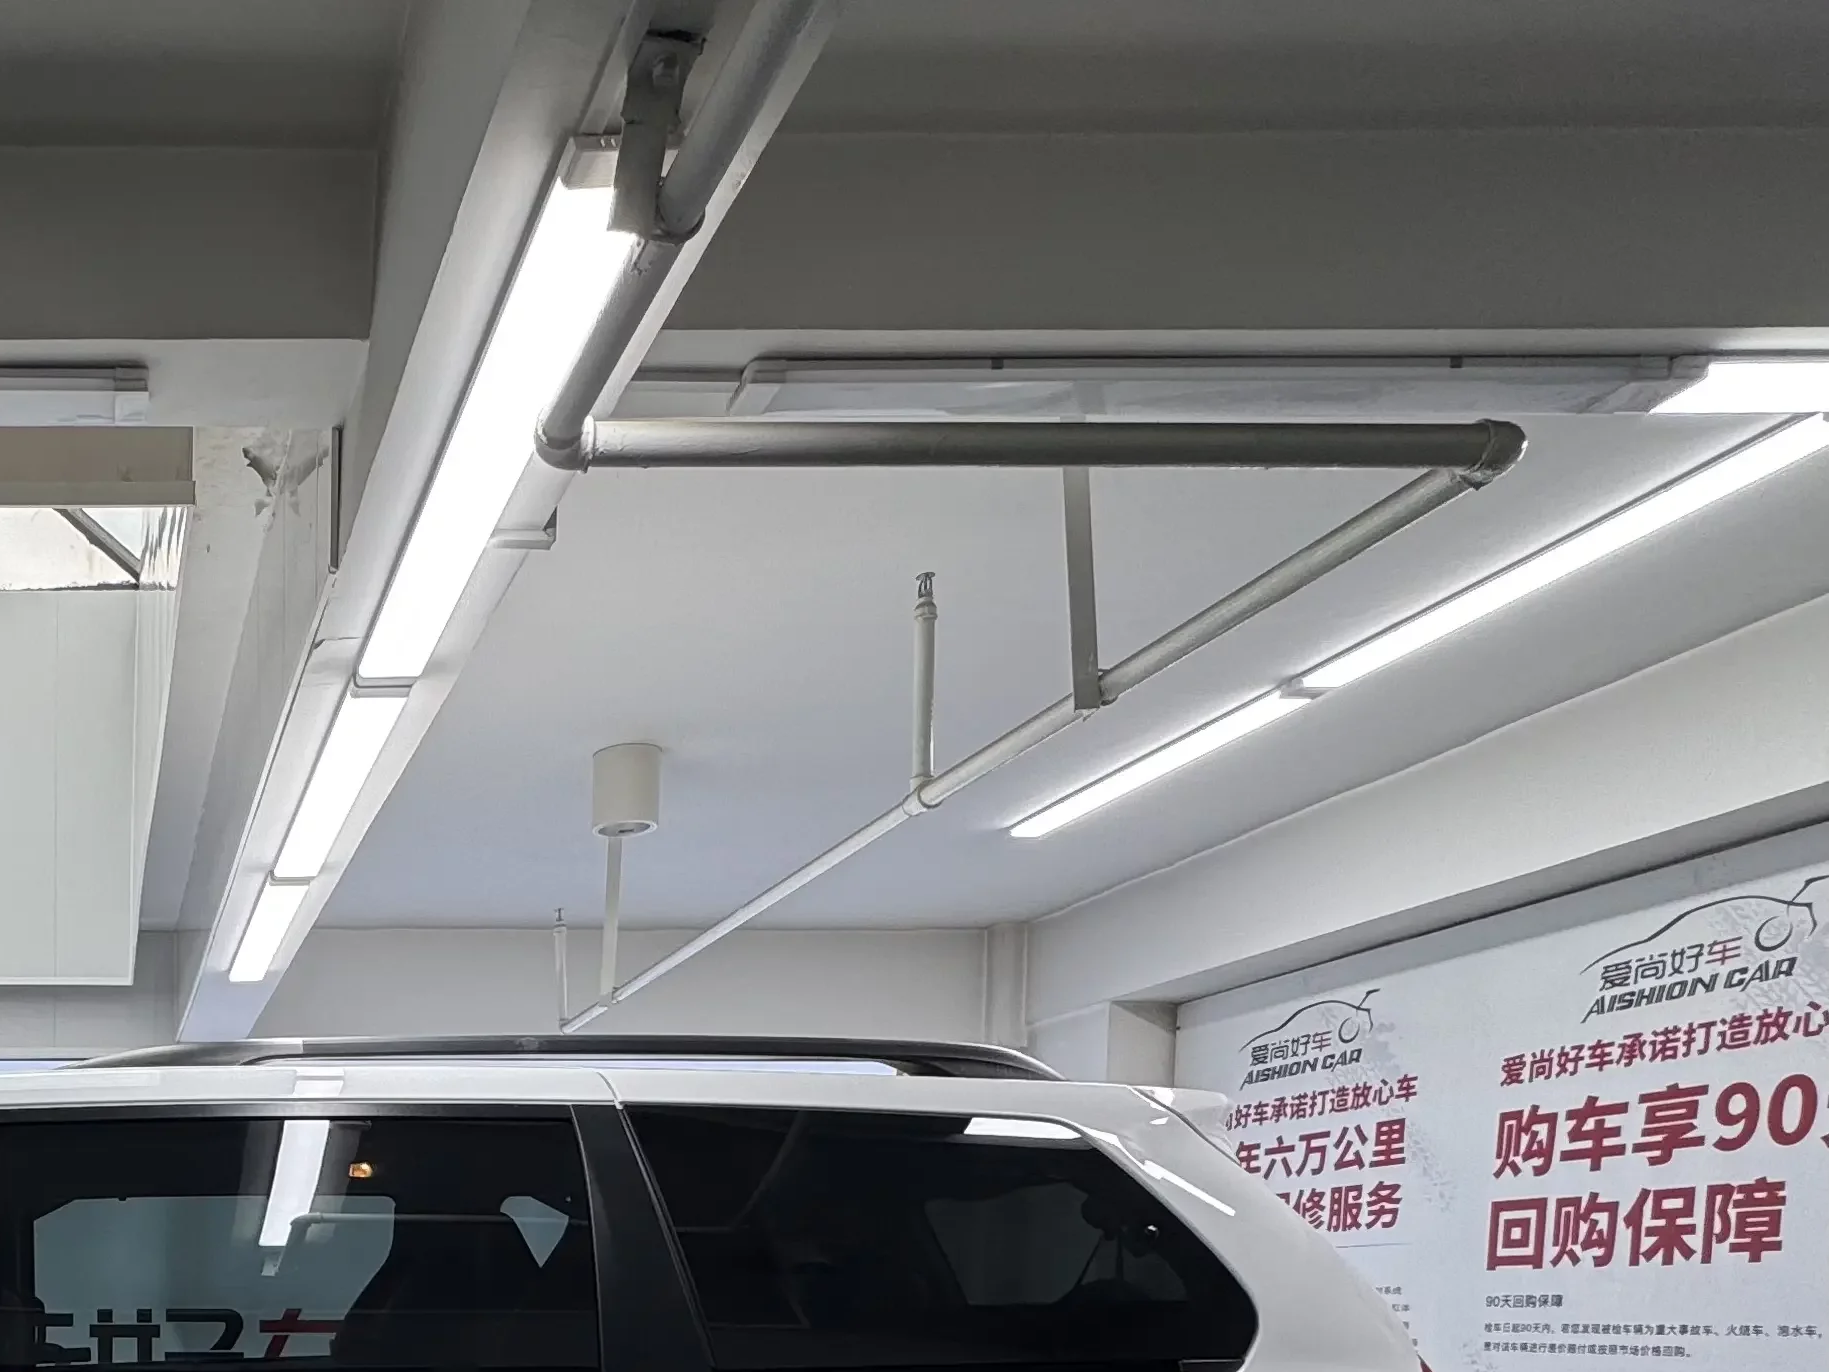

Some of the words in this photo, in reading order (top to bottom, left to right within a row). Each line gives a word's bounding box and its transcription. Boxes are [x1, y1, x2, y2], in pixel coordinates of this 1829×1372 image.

[1580, 972, 1720, 1024] AISHION
[1723, 956, 1798, 992] CAR
[1599, 936, 1743, 992] 爱尚好车
[1239, 1057, 1318, 1091] AISHION
[1321, 1048, 1363, 1072] CAR
[1250, 1030, 1333, 1067] 爱尚好车
[1225, 1074, 1418, 1131] 好车承诺打造放心车
[1492, 1073, 1829, 1179] 购车享90
[1275, 1181, 1403, 1233] 修服务
[1485, 1176, 1787, 1271] 回购保障
[1485, 1294, 1564, 1308] 90天回购保障
